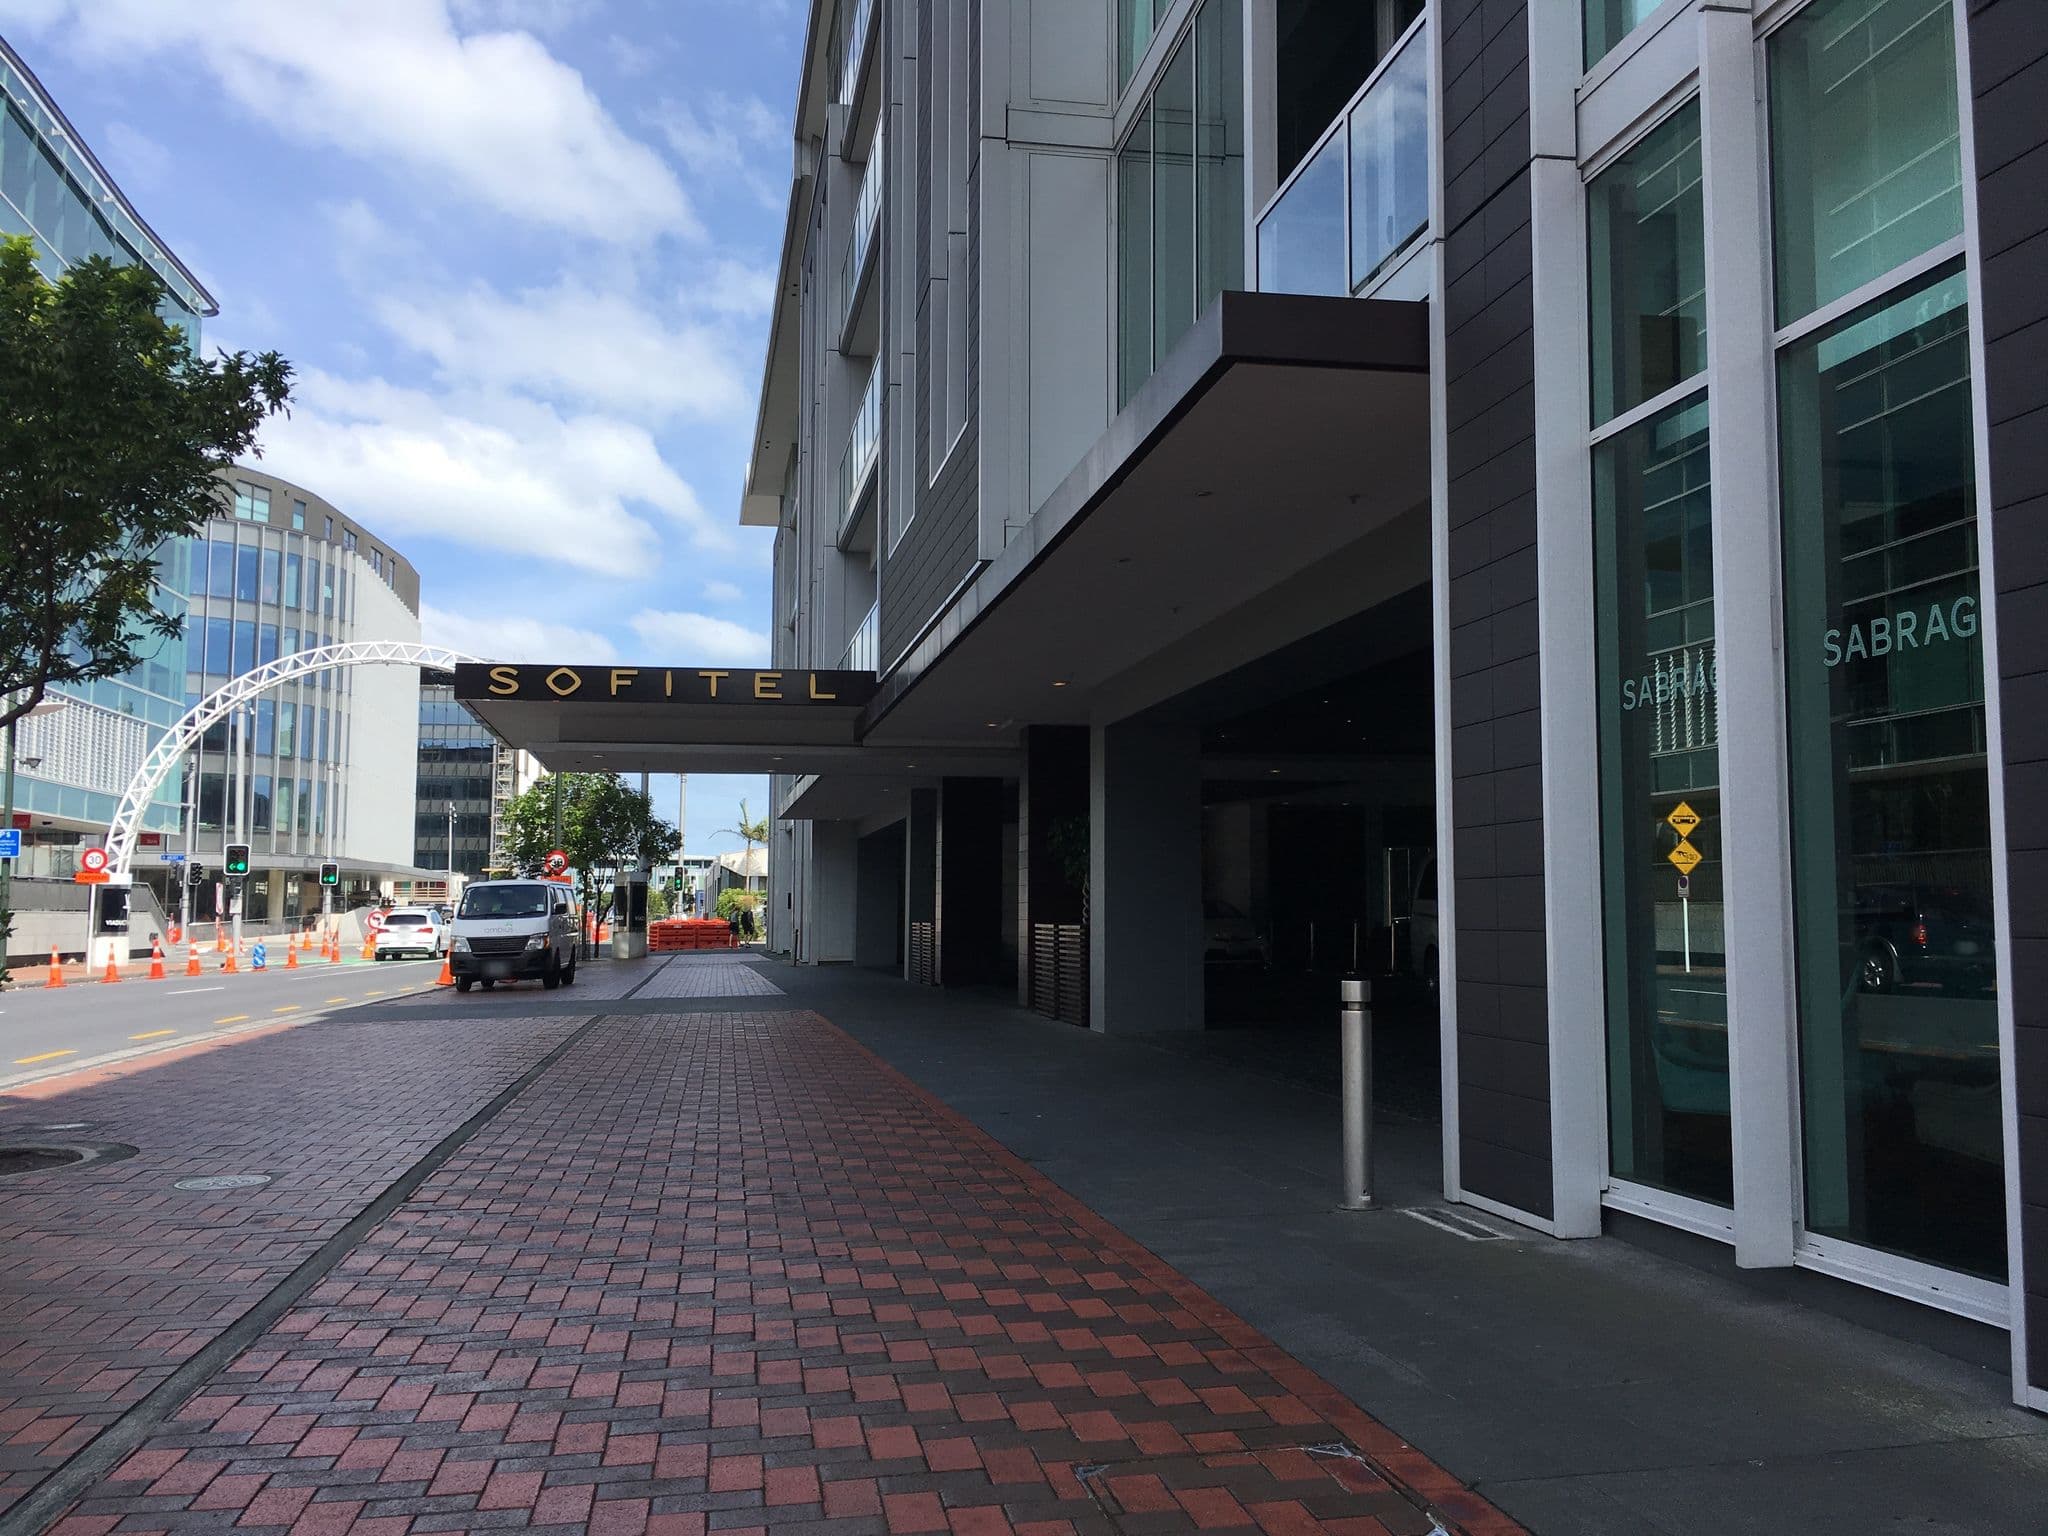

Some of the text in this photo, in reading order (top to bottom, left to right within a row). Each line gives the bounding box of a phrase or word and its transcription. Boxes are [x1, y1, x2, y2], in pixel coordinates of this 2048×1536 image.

[1823, 596, 1977, 668] SABRAG
[488, 666, 836, 699] SOFITEL
[88, 855, 102, 865] 30
